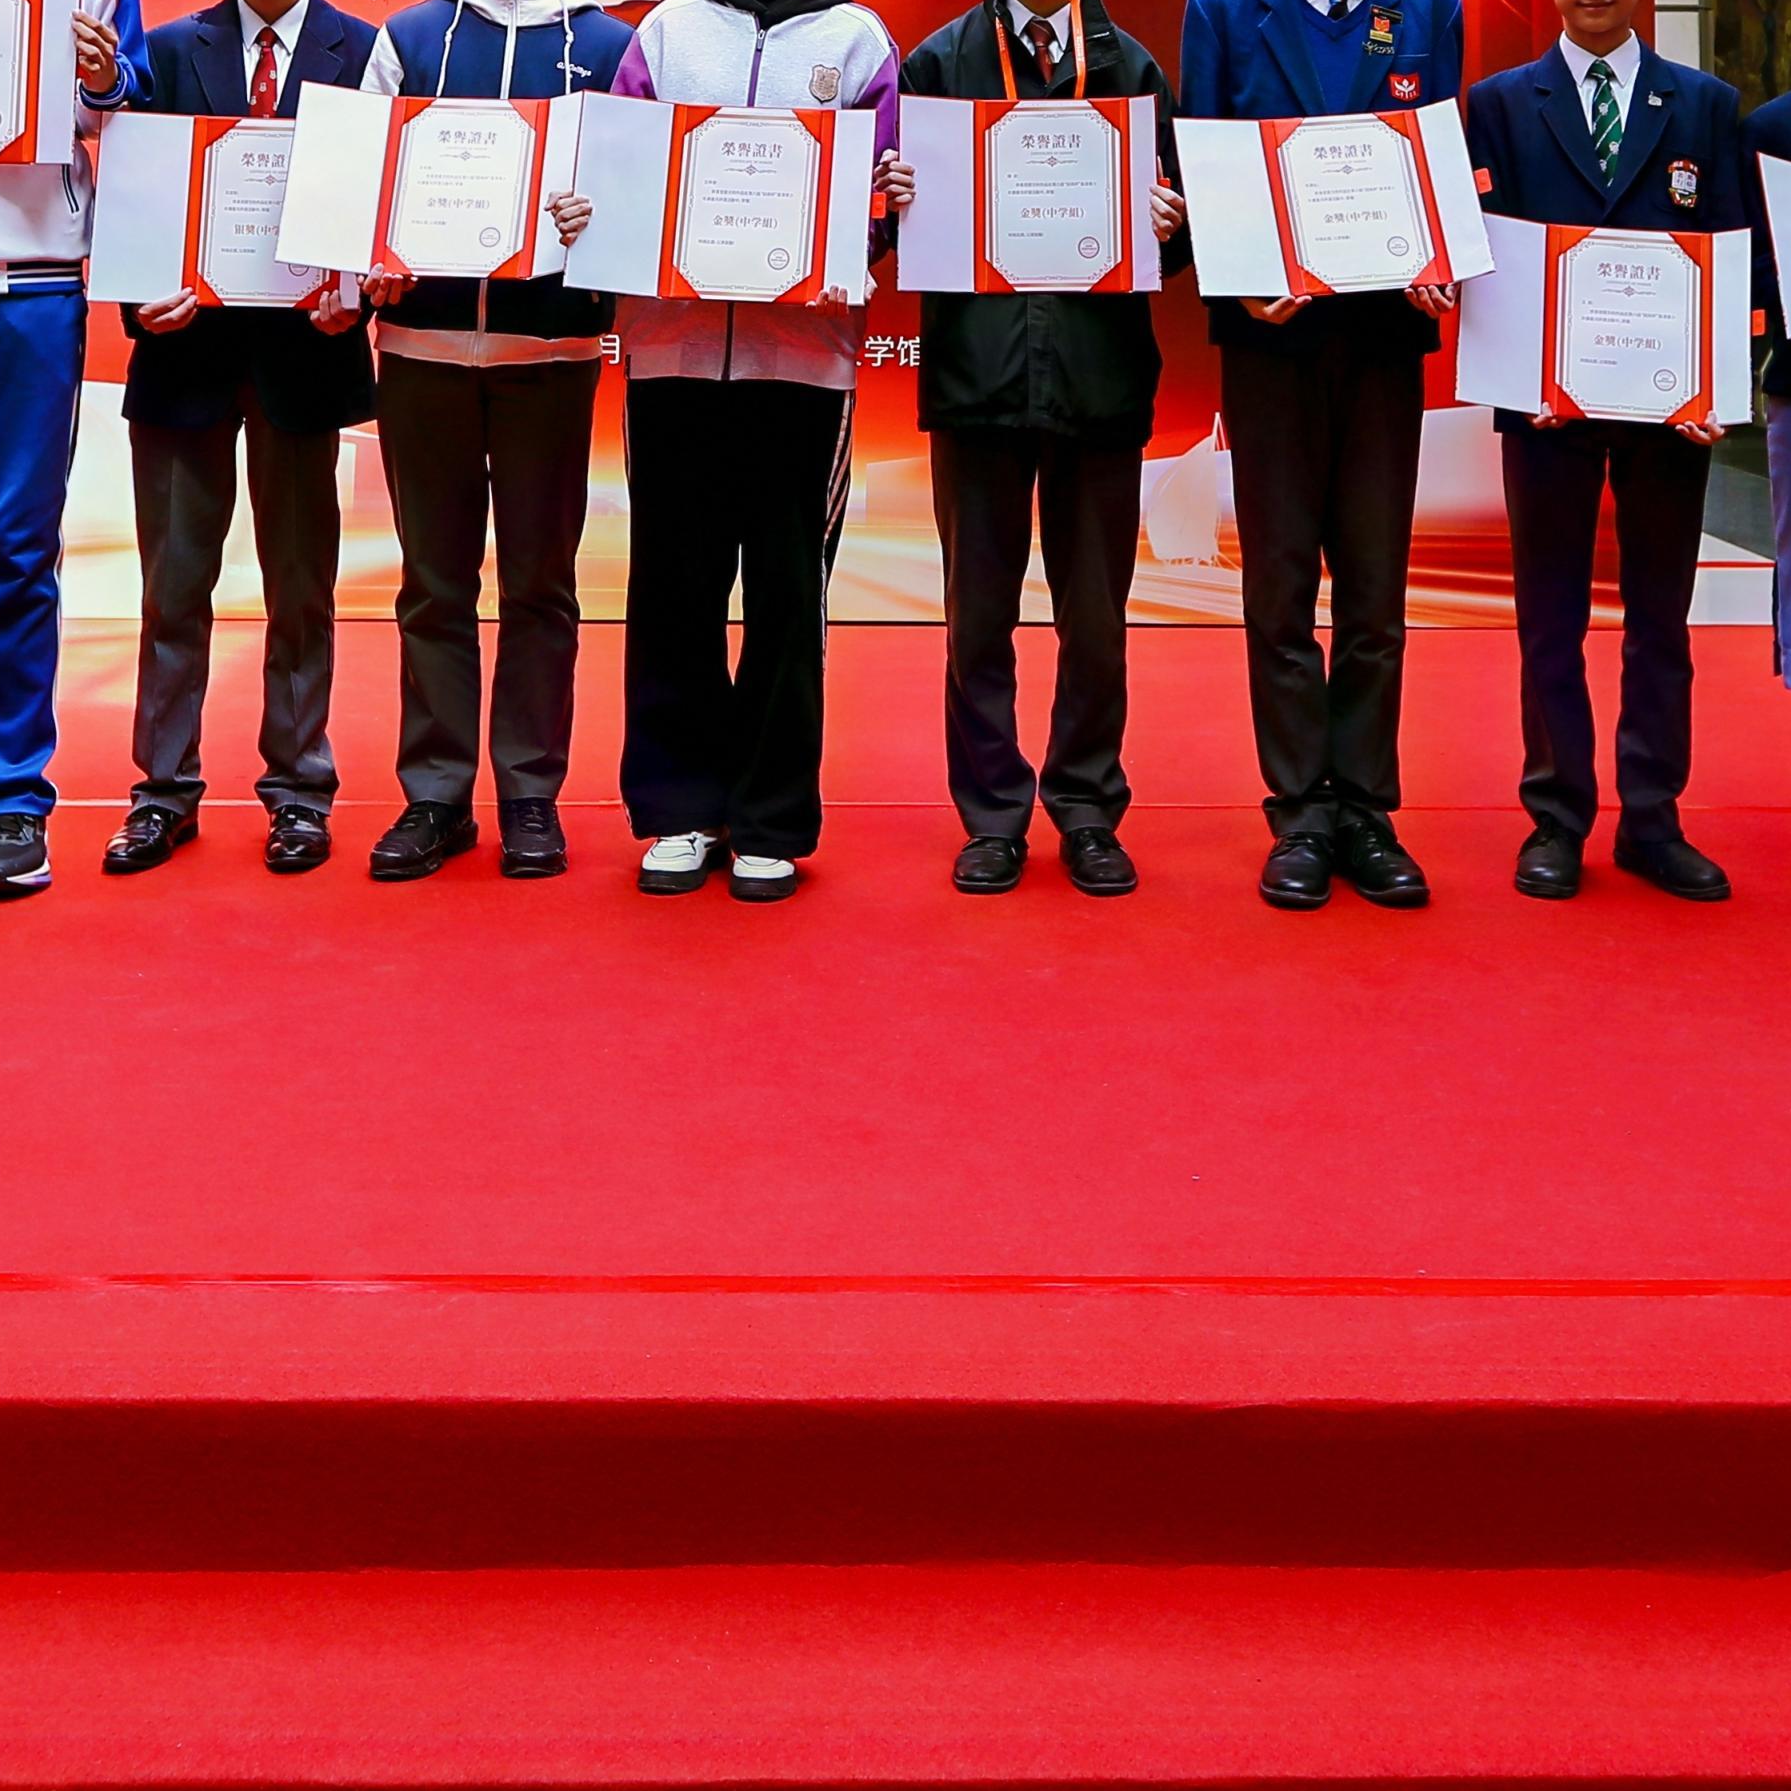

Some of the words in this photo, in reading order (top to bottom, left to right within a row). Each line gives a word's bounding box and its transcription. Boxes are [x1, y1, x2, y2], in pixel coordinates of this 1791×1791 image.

[437, 130, 498, 145] 榮譽證書
[1020, 133, 1082, 149] 榮譽證書
[721, 141, 784, 159] 榮譽證書
[1313, 143, 1374, 160] 榮譽證書
[240, 153, 288, 169] 榮譽證
[1596, 262, 1662, 280] 榮譽證書
[856, 335, 921, 367] 学馆
